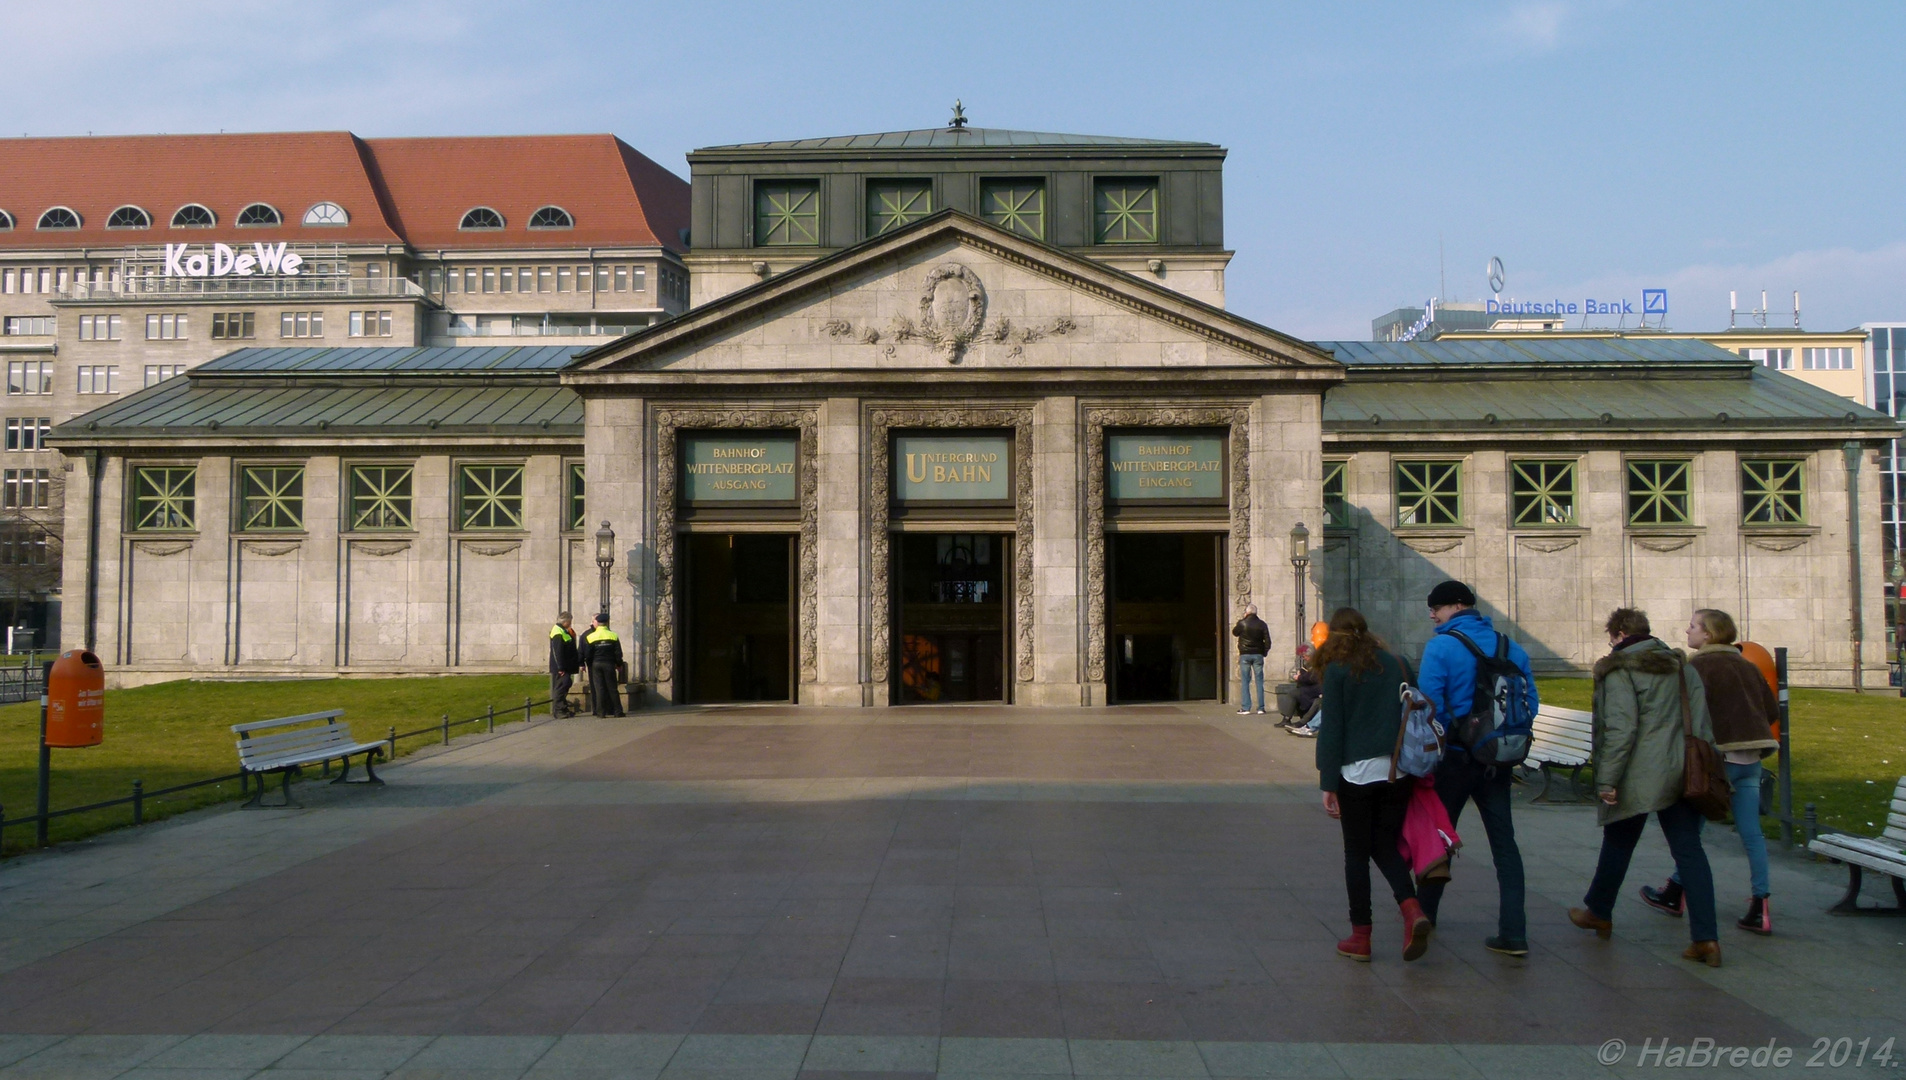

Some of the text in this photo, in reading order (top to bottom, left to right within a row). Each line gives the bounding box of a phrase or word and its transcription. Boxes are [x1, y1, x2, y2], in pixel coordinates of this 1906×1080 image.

[165, 242, 303, 277] KaDeWe
[1485, 299, 1633, 315] Deutsche Bank
[713, 448, 766, 458] BAHNHOF
[1138, 445, 1192, 455] BAHNHOF
[686, 463, 794, 474] WITTENBERGPLATZ
[1111, 461, 1220, 472] WITTENBERGPLATZ
[934, 465, 992, 483] BAHN
[1139, 478, 1192, 488] EINGANG
